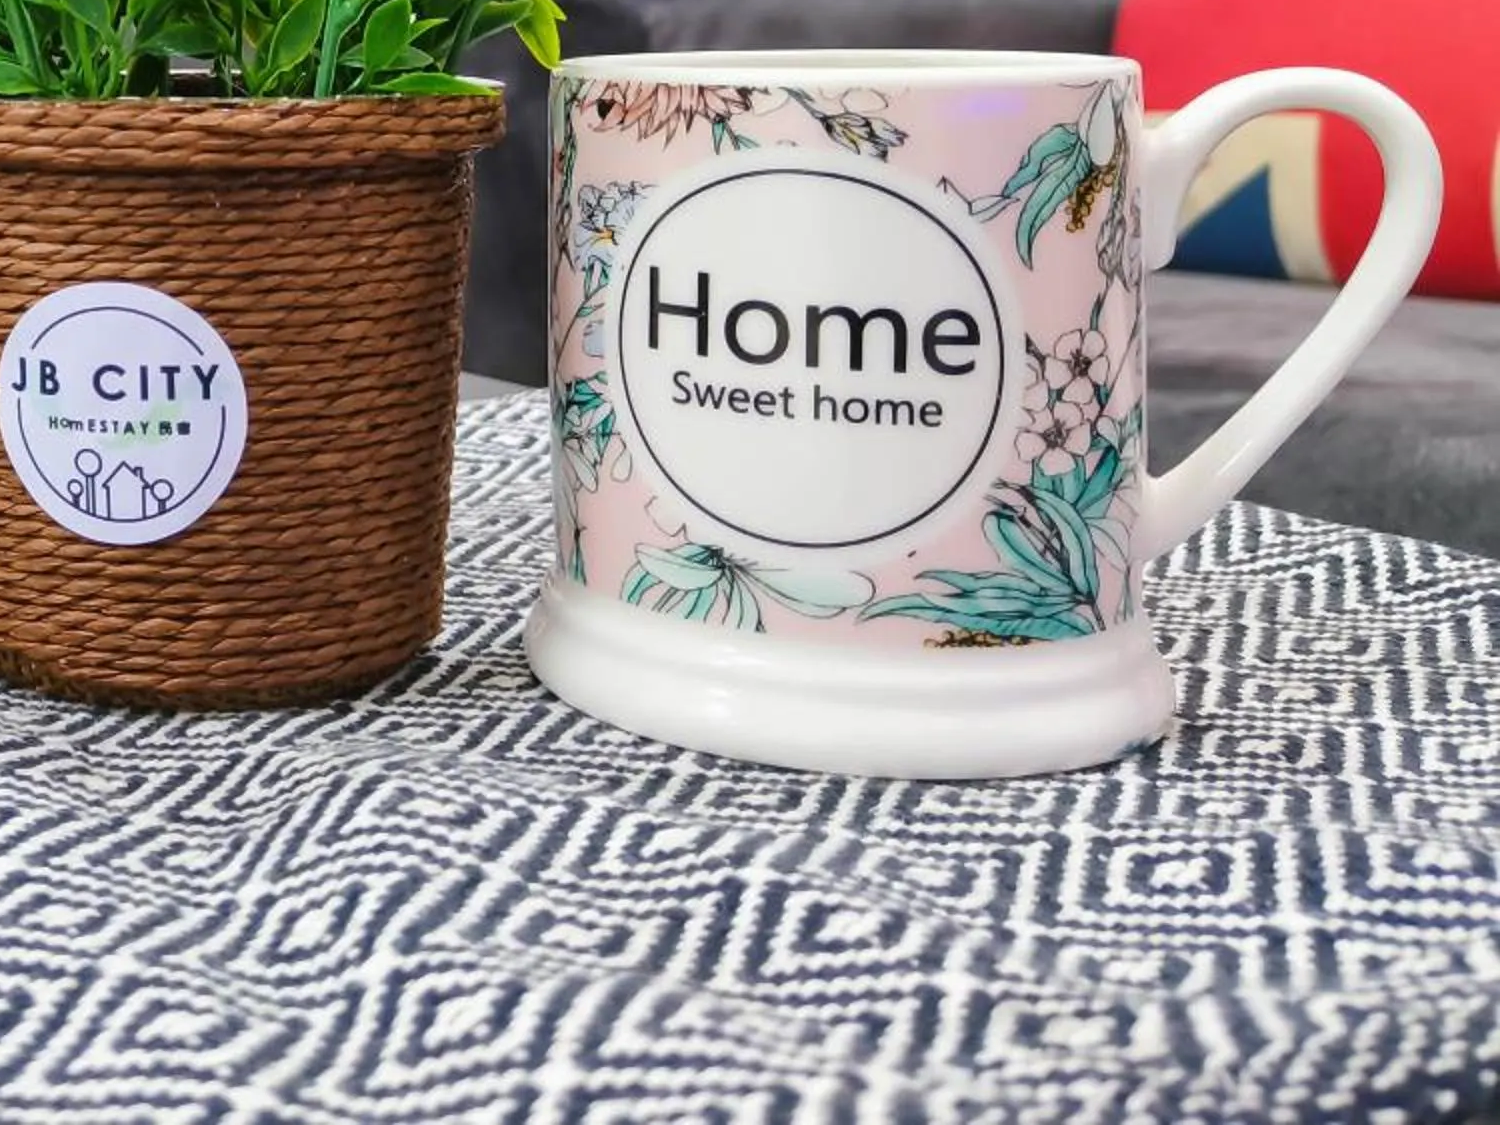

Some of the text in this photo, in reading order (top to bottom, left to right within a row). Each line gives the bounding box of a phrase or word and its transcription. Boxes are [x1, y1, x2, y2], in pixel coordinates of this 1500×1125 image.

[648, 265, 981, 376] Home
[11, 356, 219, 401] JB CITY
[671, 370, 944, 428] Sweet home
